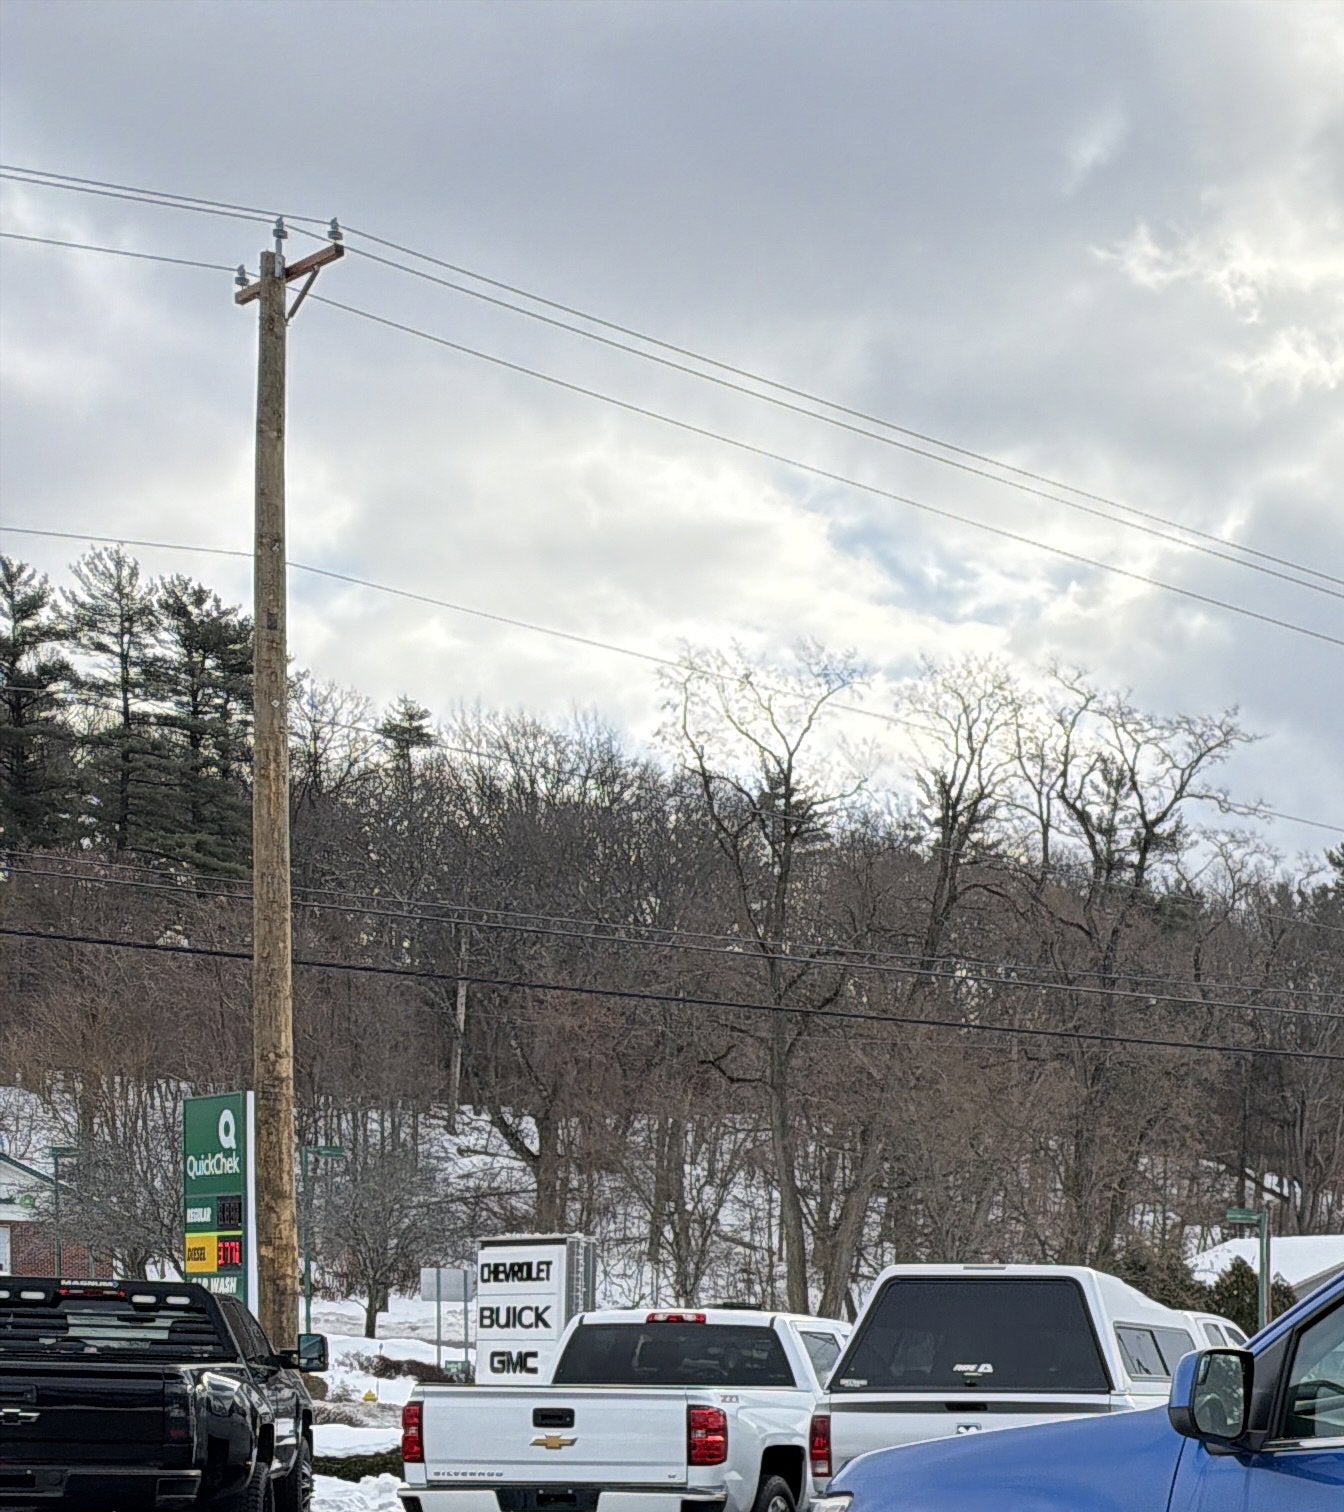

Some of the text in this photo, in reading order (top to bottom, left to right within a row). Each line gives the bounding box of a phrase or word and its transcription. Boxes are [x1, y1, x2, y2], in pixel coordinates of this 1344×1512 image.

[219, 1109, 236, 1149] Q
[186, 1151, 240, 1180] QuickChek
[187, 1246, 207, 1262] DIESEL
[60, 1279, 113, 1287] MAGNUM
[480, 1260, 553, 1283] CHEVROLET
[210, 1276, 238, 1294] WASH
[479, 1305, 552, 1330] BUICK
[489, 1350, 538, 1374] GMC
